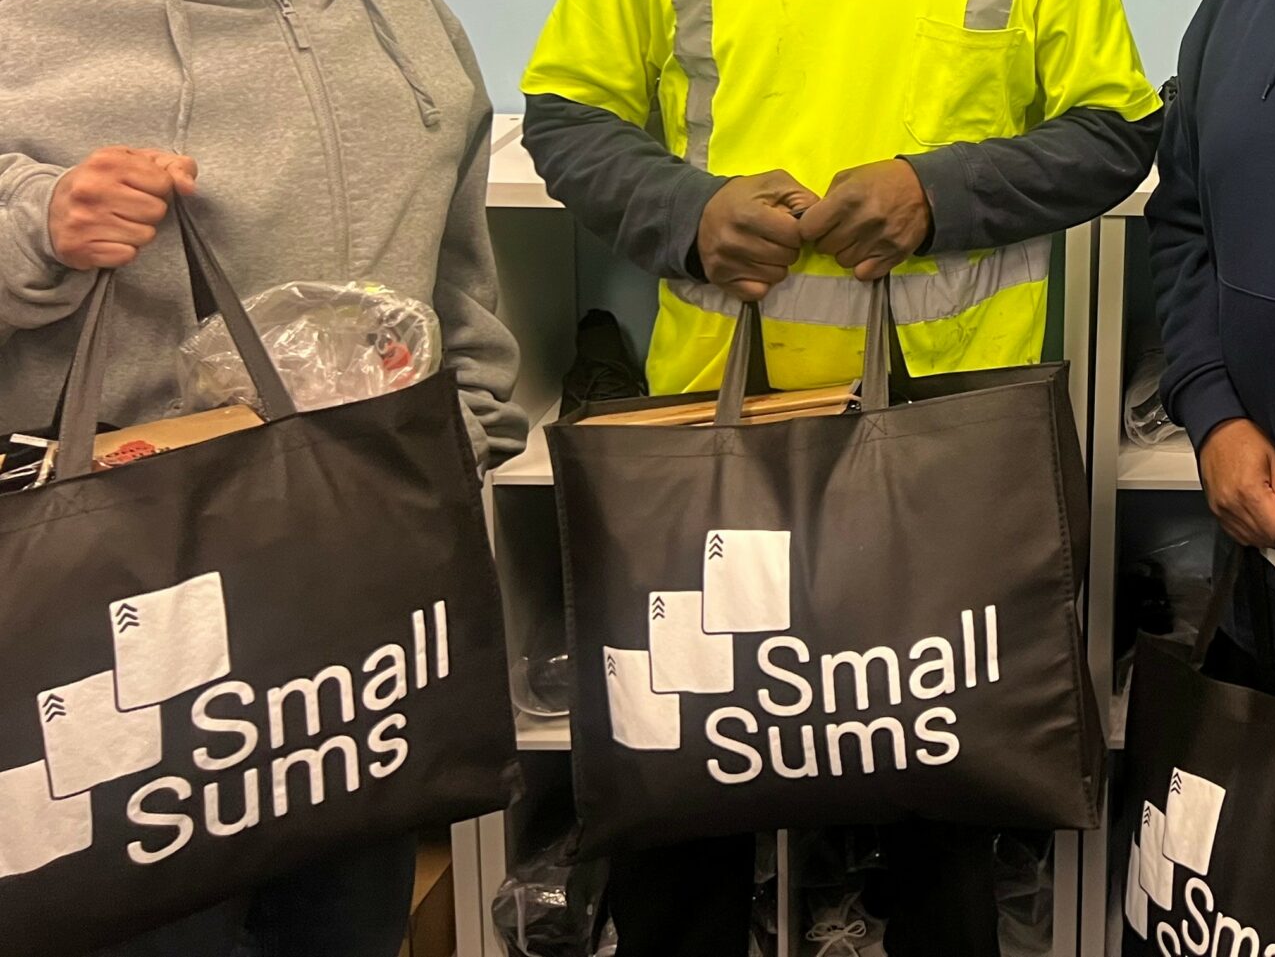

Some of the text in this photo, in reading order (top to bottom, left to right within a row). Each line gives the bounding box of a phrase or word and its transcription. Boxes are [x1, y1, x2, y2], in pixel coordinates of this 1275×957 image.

[191, 600, 449, 771] Small
[757, 605, 1000, 717] Small
[127, 713, 409, 864] Sums
[706, 706, 960, 785] Sums
